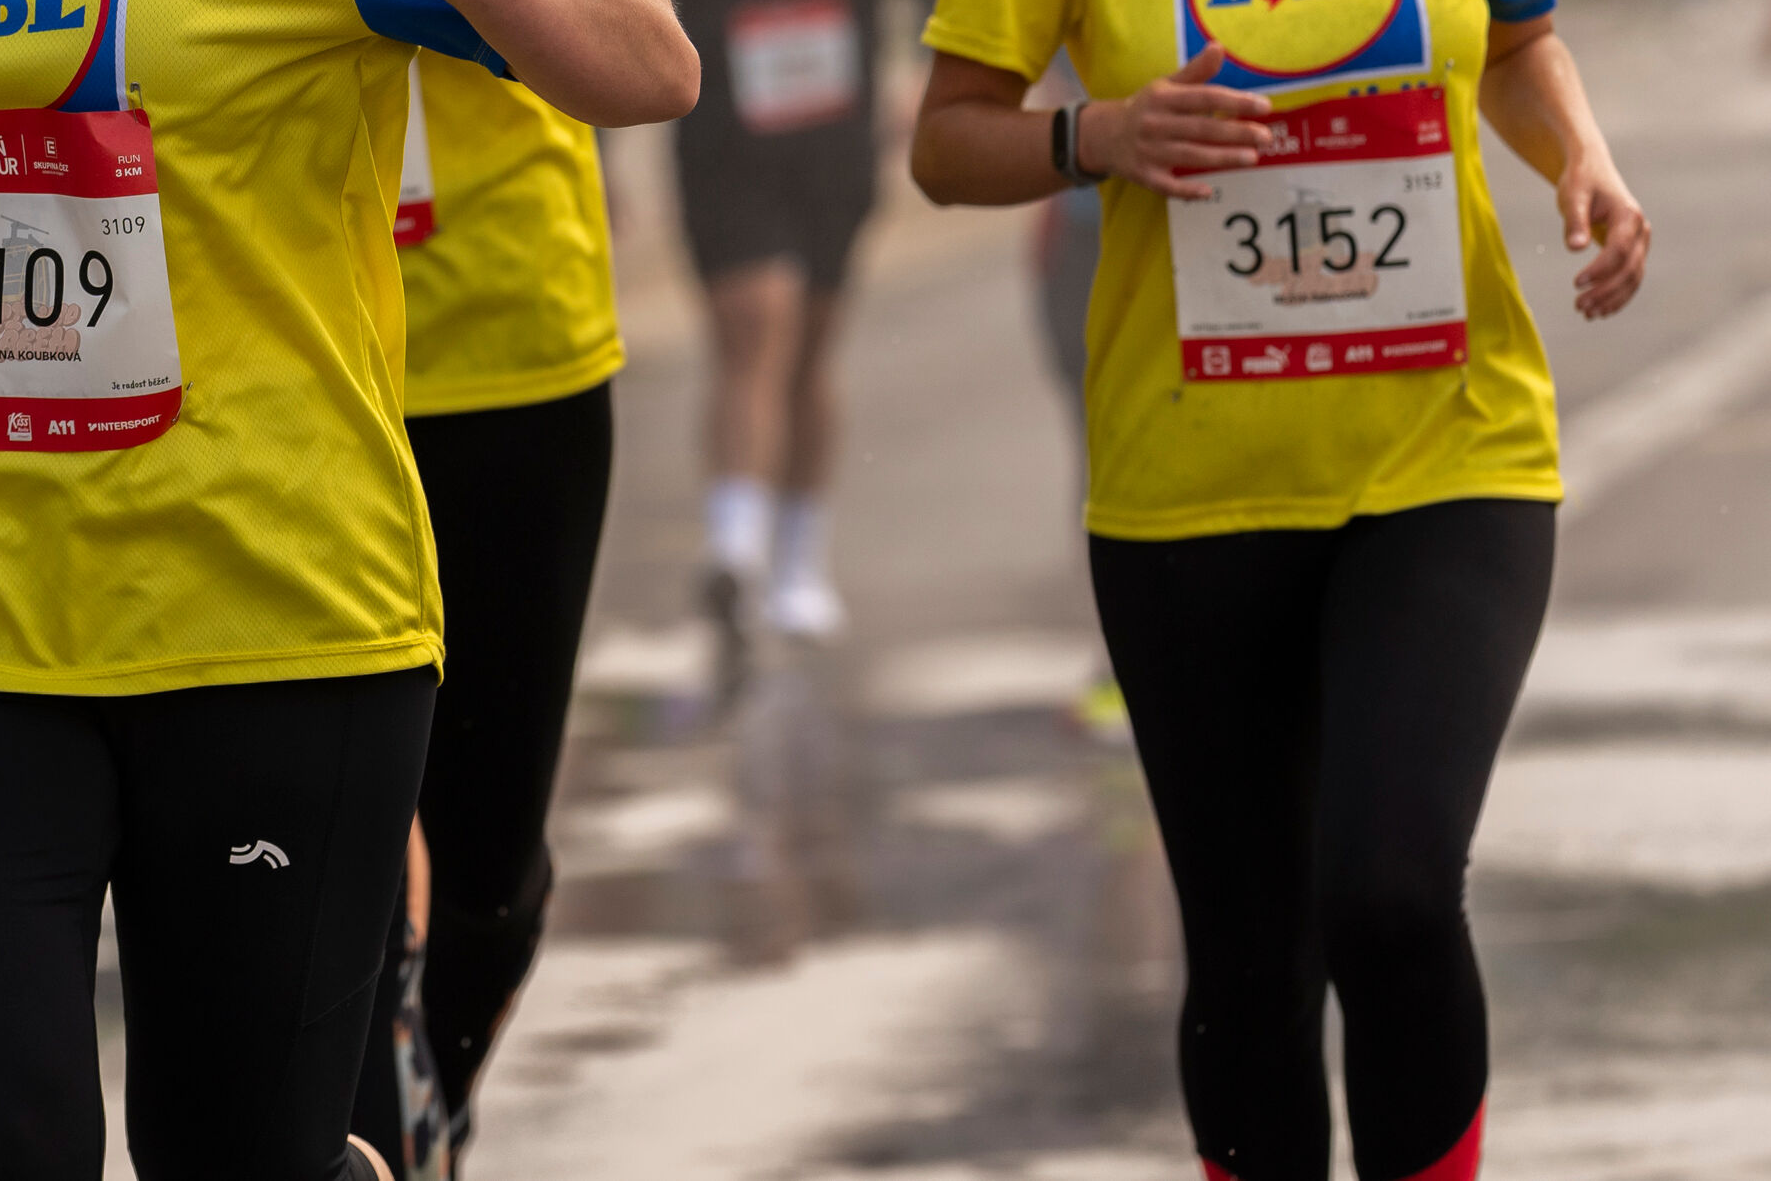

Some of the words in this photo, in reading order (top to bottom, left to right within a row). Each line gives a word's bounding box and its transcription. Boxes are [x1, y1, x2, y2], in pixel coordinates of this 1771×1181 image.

[33, 161, 58, 170] SKUPINA
[117, 154, 141, 165] RUN
[115, 169, 123, 178] 3
[124, 167, 142, 177] KM
[101, 216, 146, 235] 3109
[1224, 204, 1410, 277] 3152
[18, 348, 82, 362] KOUBKOVÁ
[111, 381, 121, 391] Je
[122, 379, 147, 390] radost
[148, 376, 171, 387] běžet.
[48, 420, 76, 435] A11
[97, 414, 161, 432] INTERSPORT
